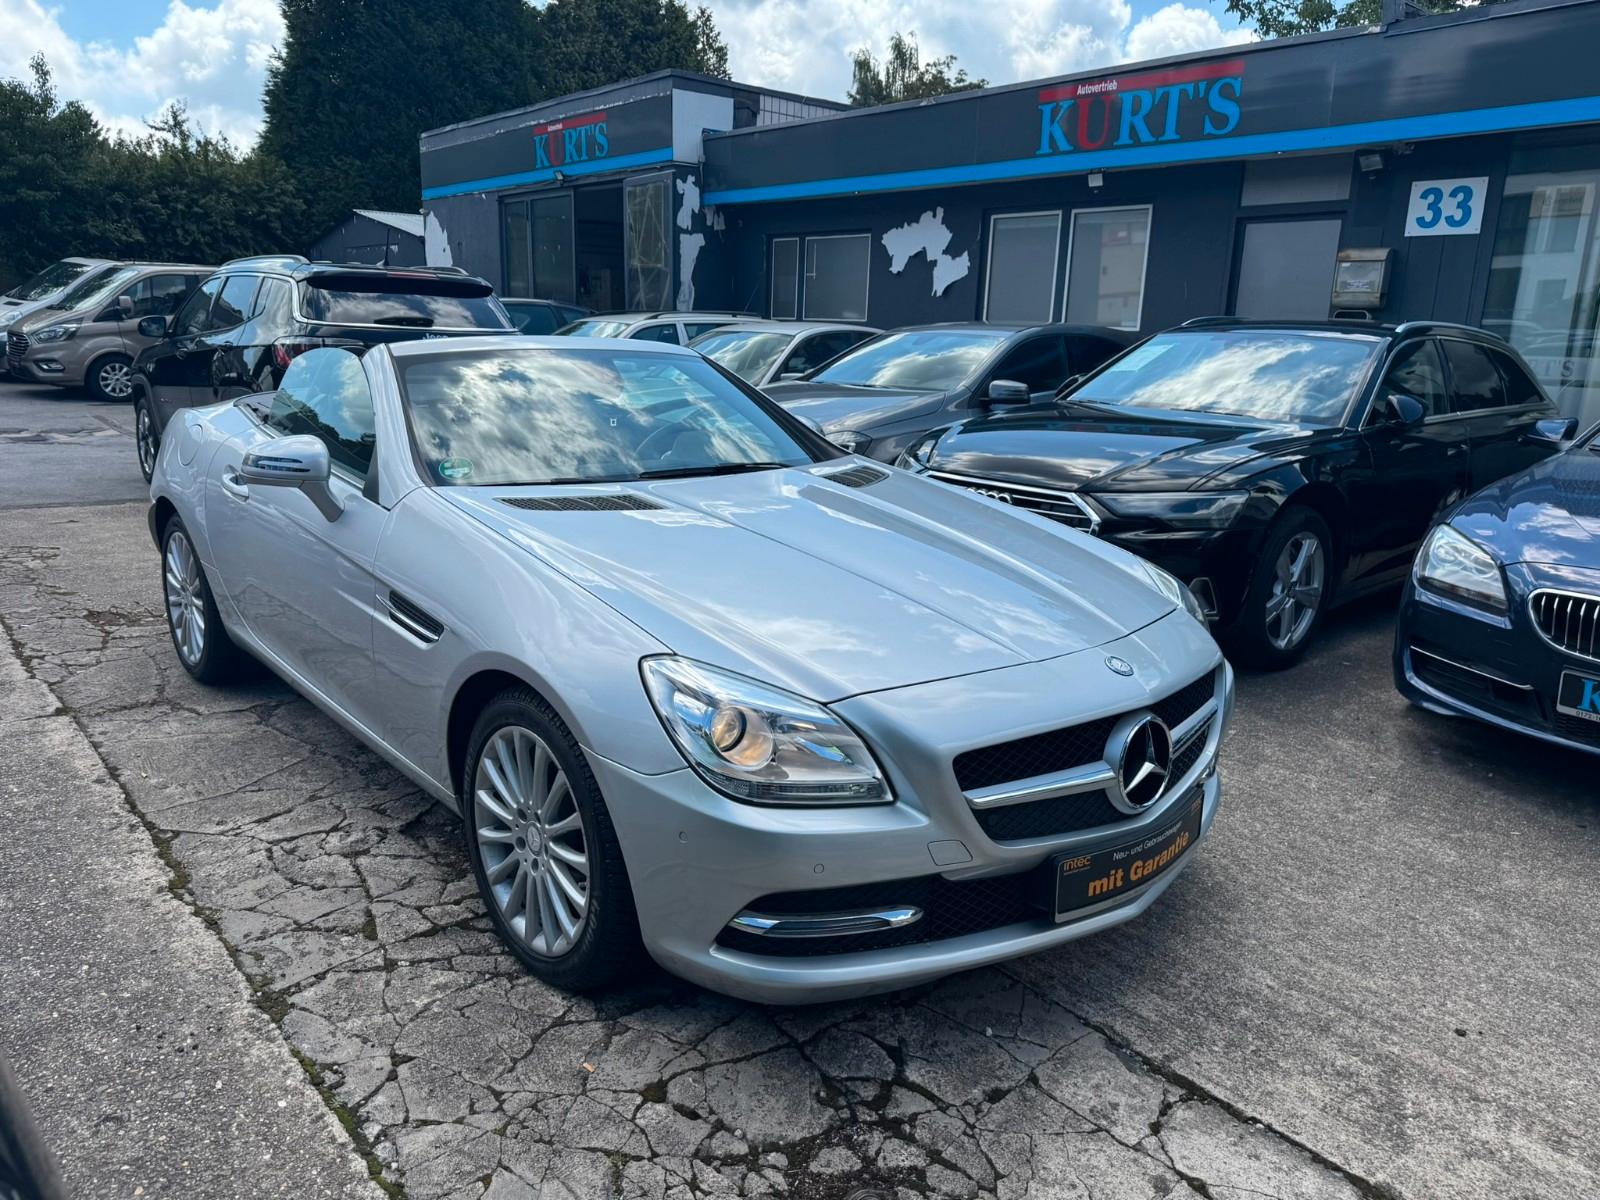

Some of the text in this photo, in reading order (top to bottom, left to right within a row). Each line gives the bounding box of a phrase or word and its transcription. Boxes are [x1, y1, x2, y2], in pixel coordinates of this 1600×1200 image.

[1076, 79, 1118, 95] Autovertrieb
[1036, 77, 1242, 154] KURT'S
[533, 122, 609, 168] KURT'S
[1415, 185, 1473, 229] 33
[422, 332, 449, 341] Jee
[1063, 856, 1091, 871] intec
[1088, 832, 1190, 896] mit Garantie
